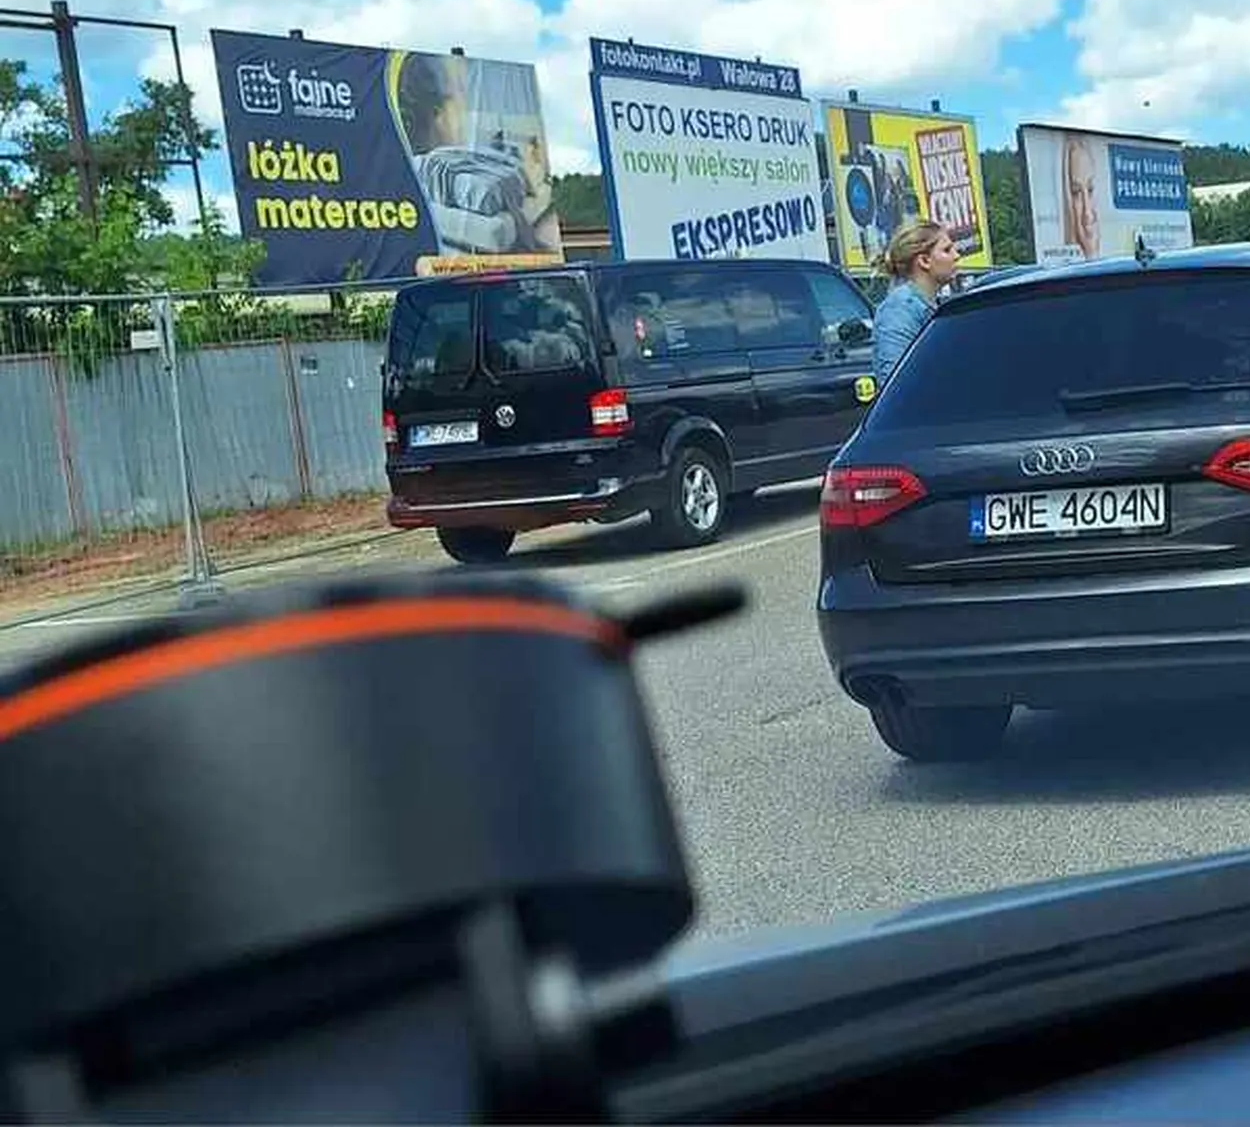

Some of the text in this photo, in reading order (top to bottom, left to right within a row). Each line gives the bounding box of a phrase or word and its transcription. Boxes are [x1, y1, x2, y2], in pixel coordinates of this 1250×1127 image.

[600, 42, 702, 81] fotokontakt.pl
[288, 69, 352, 107] fajne
[611, 100, 811, 147] FOTO KSERO DRUK
[247, 139, 340, 182] łóżka
[623, 146, 810, 186] nowy większy salon
[255, 194, 418, 229] materace
[671, 194, 817, 259] EKSPRESOWO
[988, 486, 1160, 531] GWE 4604N
